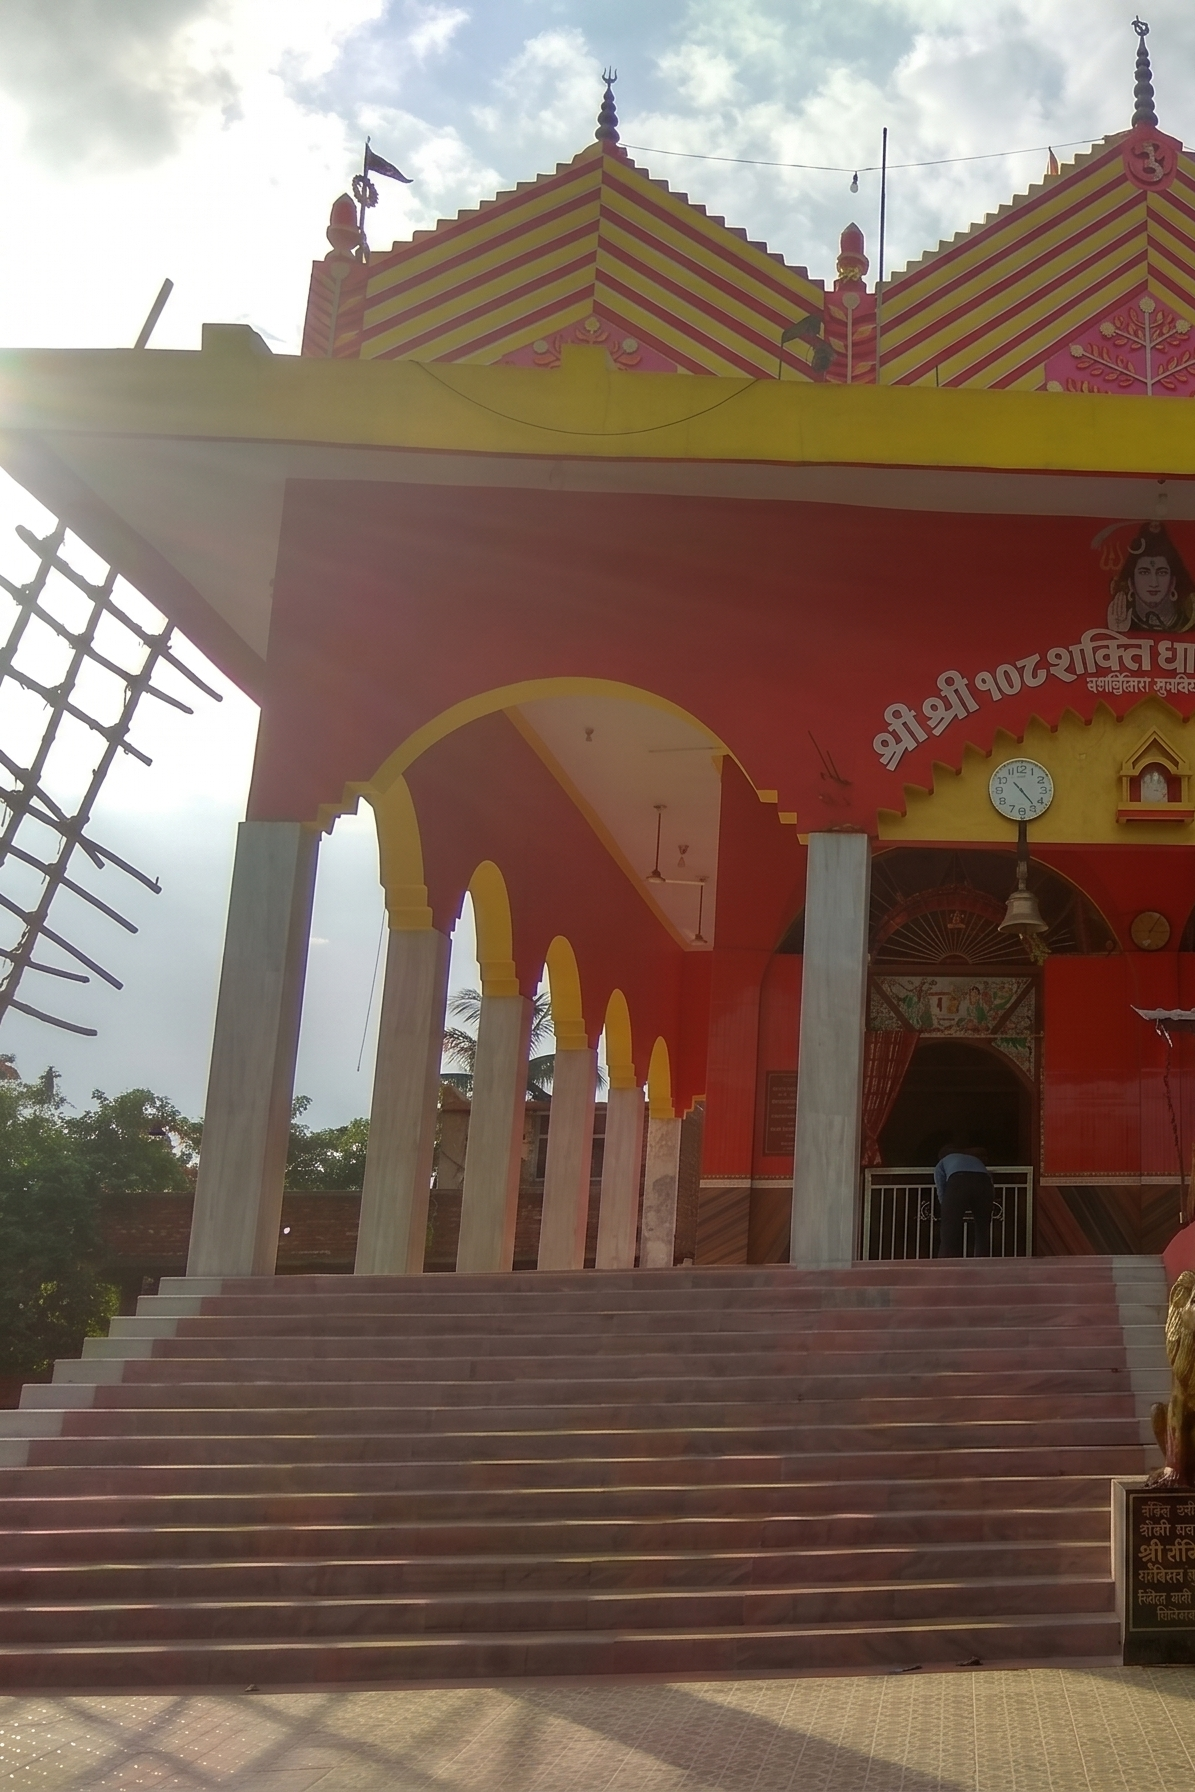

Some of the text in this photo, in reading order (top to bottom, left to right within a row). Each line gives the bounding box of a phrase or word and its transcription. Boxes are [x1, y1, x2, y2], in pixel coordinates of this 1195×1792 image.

[872, 703, 928, 771] श्री
[921, 670, 980, 737] श्री
[1046, 628, 1154, 682] शक्ति
